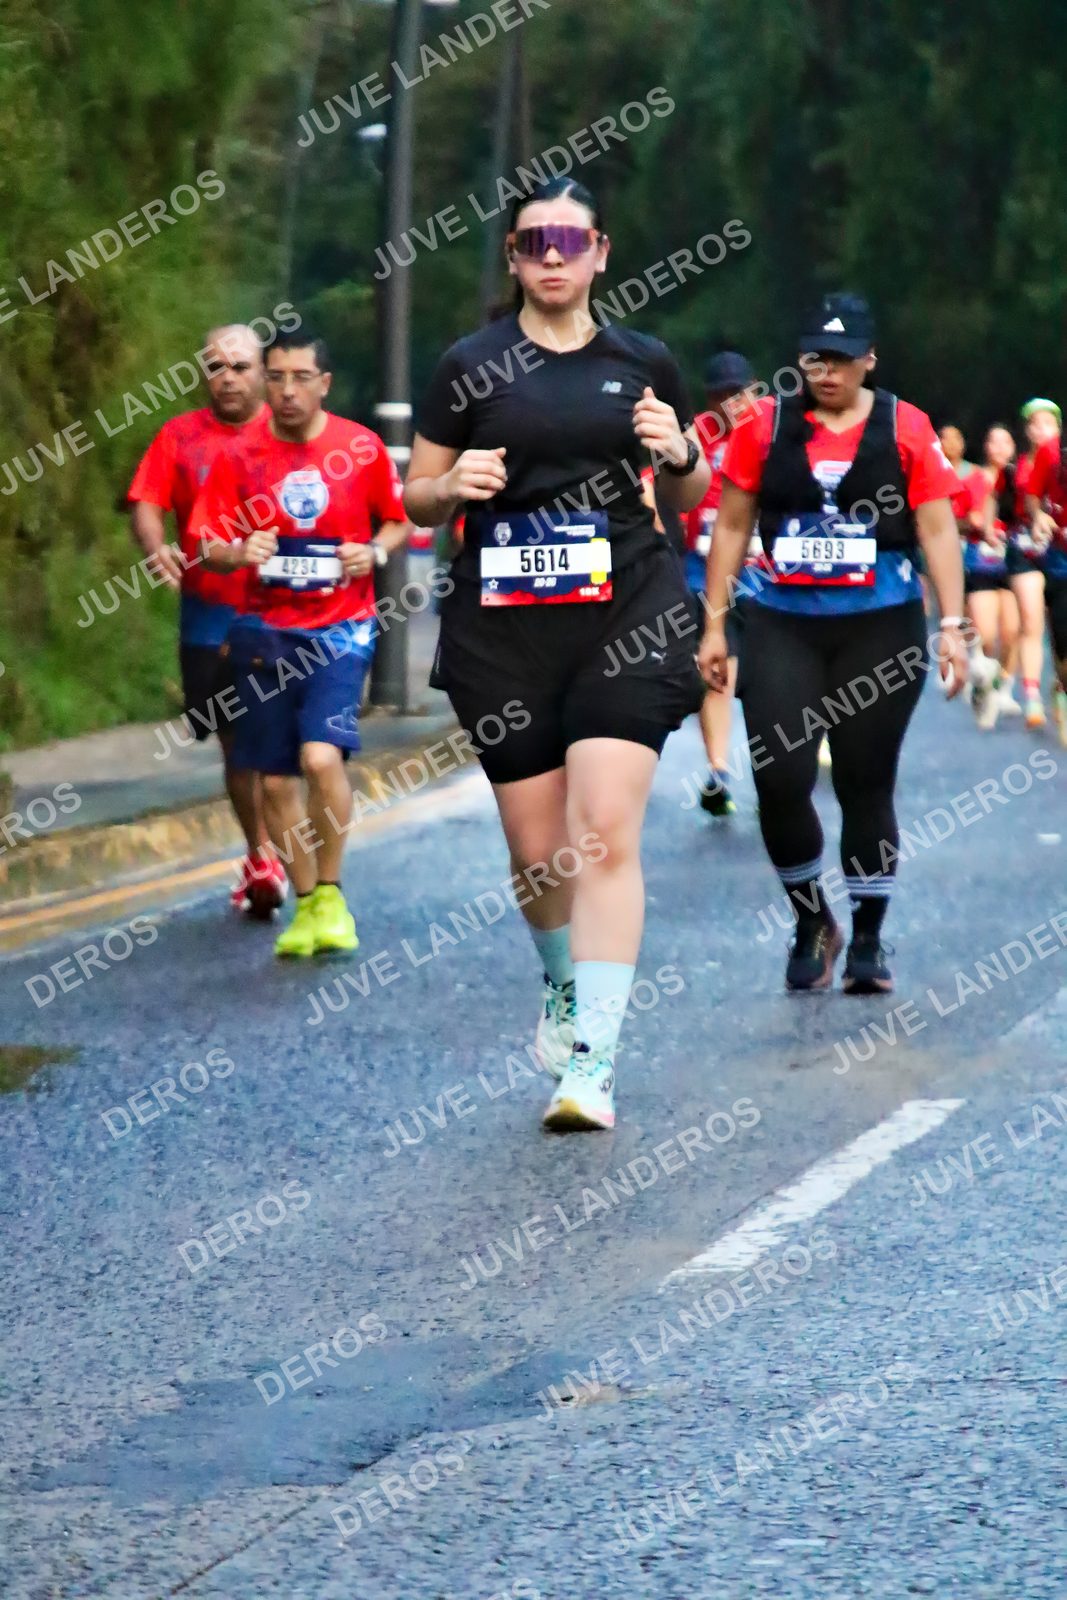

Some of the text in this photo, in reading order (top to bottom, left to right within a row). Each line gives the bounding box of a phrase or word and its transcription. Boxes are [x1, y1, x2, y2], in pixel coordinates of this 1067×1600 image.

[520, 547, 570, 573] 5614
[801, 540, 845, 560] 5693
[281, 558, 319, 576] 4234
